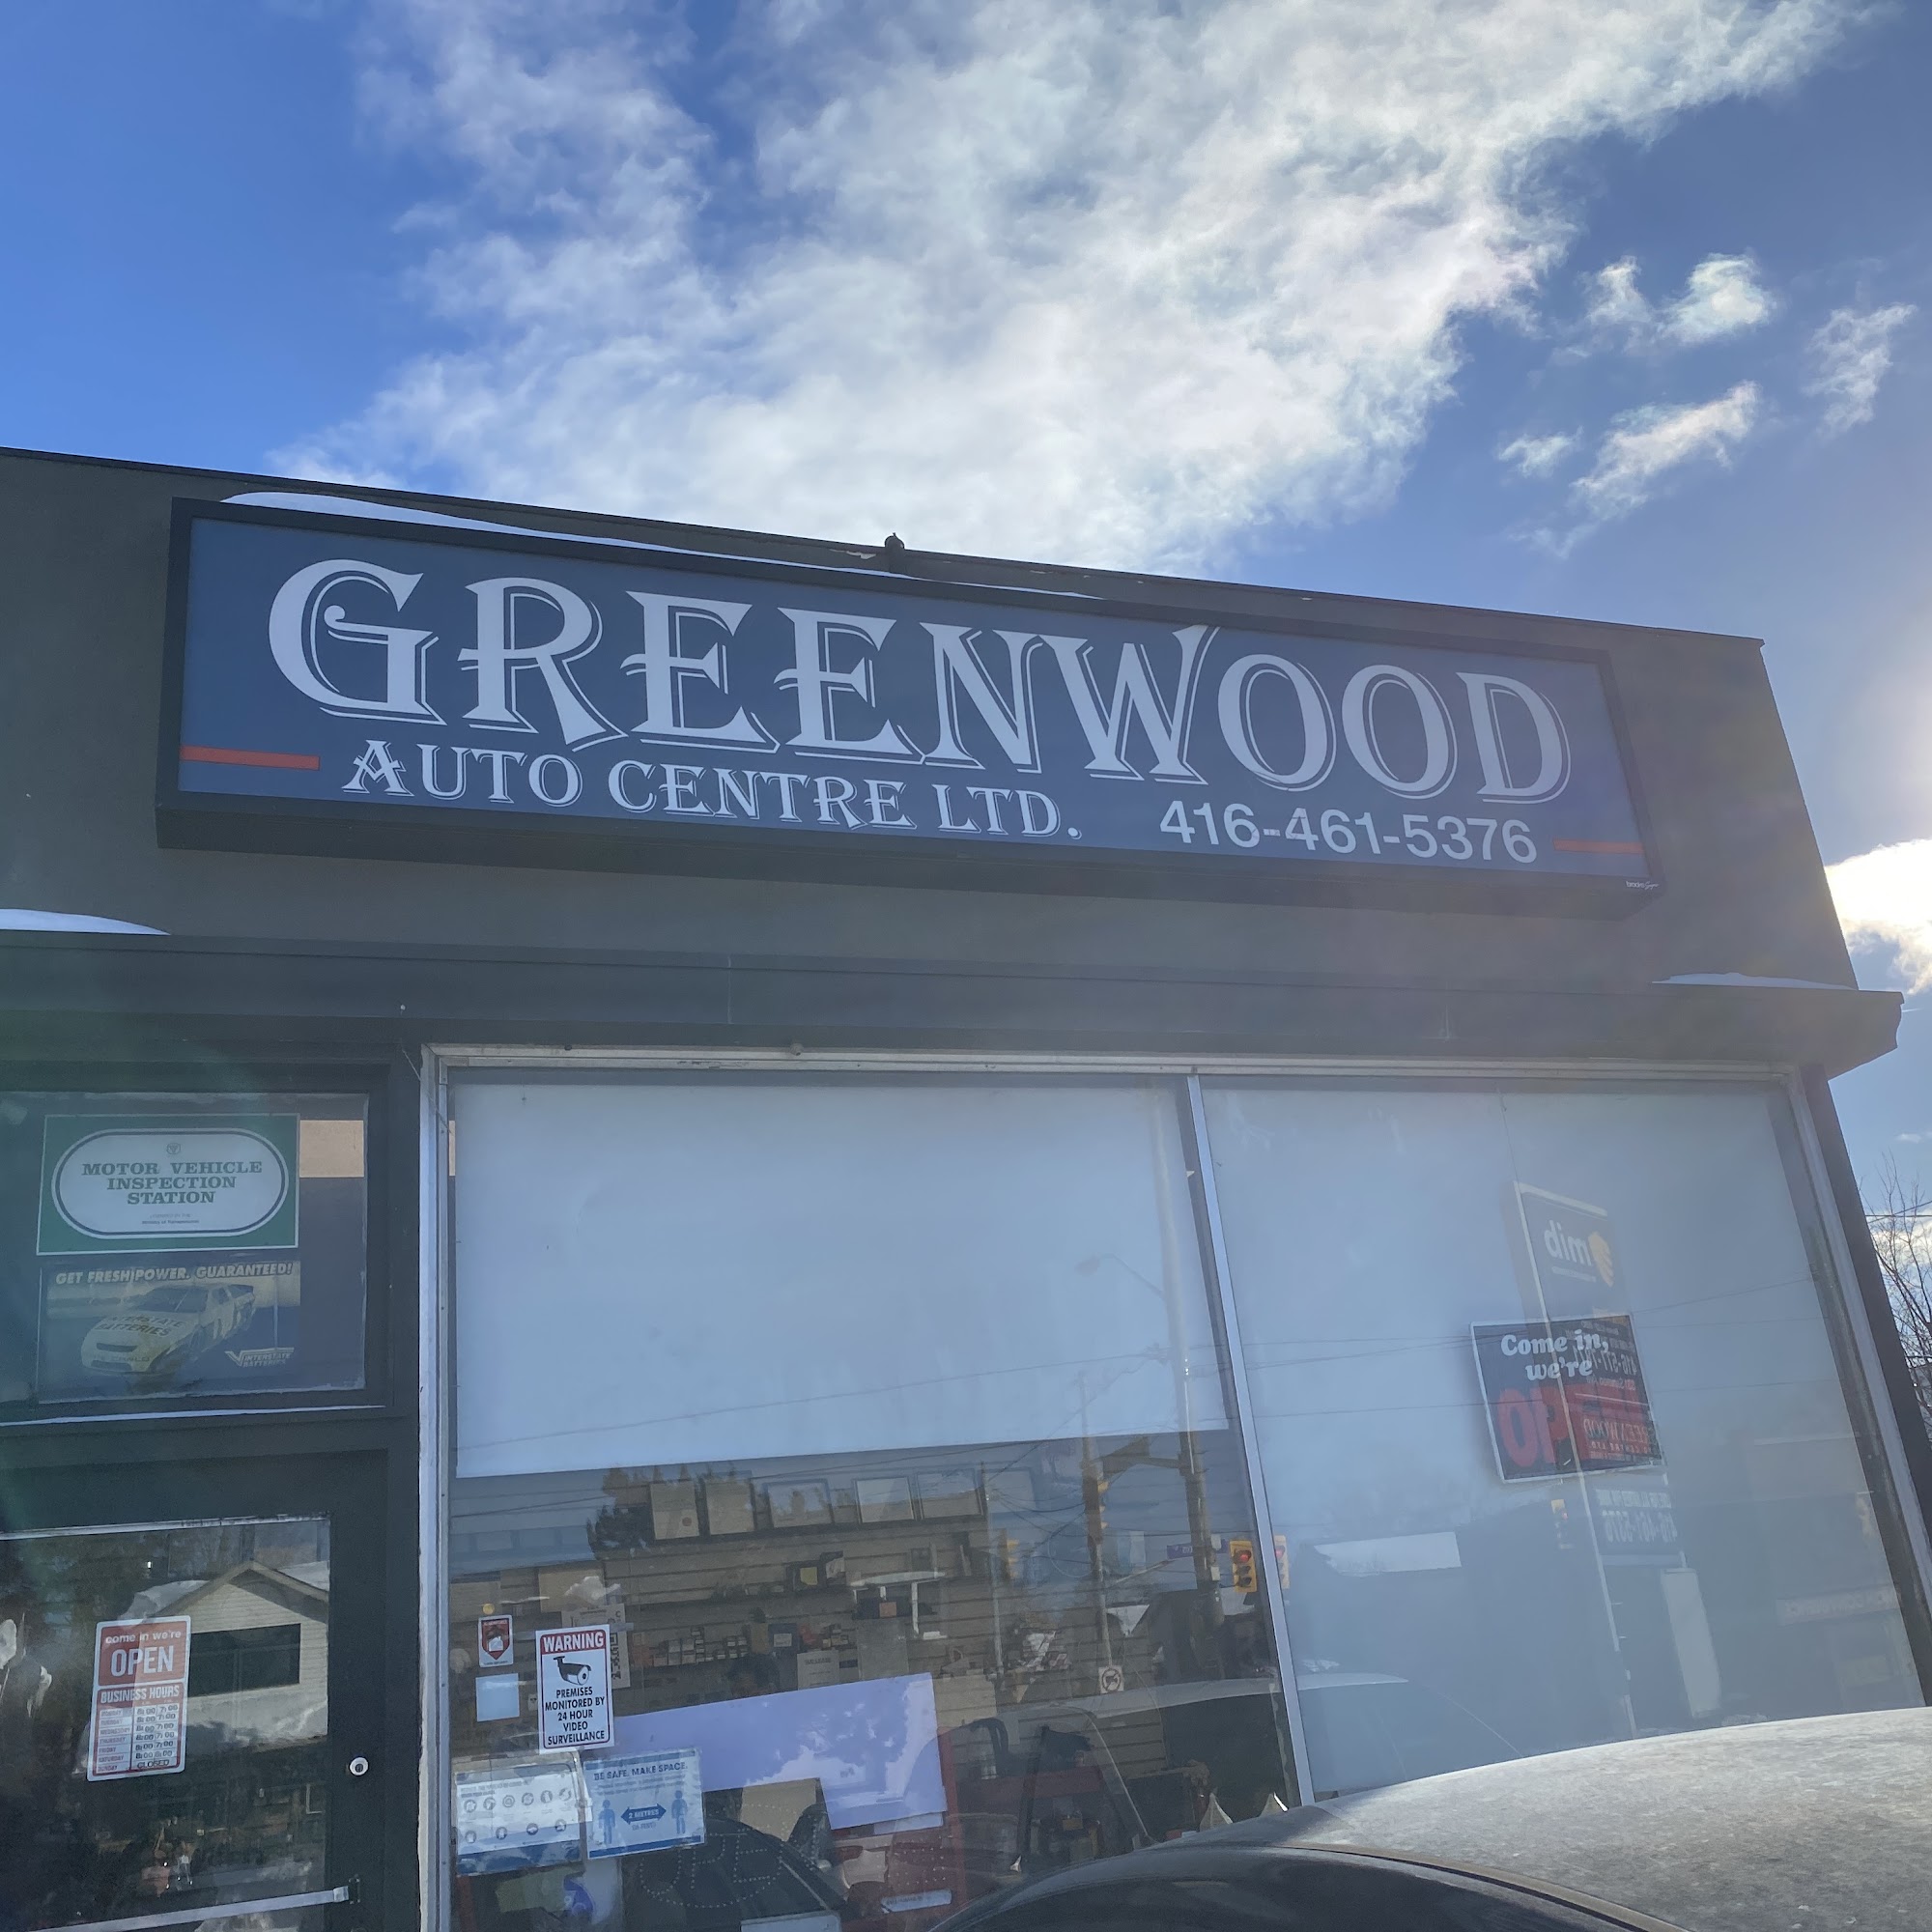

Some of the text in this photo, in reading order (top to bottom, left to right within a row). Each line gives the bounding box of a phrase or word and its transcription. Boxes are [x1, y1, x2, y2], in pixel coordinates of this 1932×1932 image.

[269, 558, 1573, 805] GREENWOOD
[341, 740, 1083, 839] AUTO CENTRE LTD.
[1159, 800, 1538, 864] 416-461-5376
[81, 1161, 263, 1176] MOTOR VEHICLE
[107, 1177, 237, 1190] INSPECTION
[128, 1191, 215, 1205] STATION
[56, 1263, 293, 1284] GET FRESH POWER. GUARANTEED!
[1501, 1334, 1567, 1356] Come
[1574, 1329, 1608, 1353] in,
[244, 1352, 291, 1361] INTERSTATE
[1525, 1356, 1592, 1380] we're
[105, 1630, 182, 1643] come in we're
[543, 1632, 604, 1653] WARNING
[111, 1645, 174, 1677] OPEN
[100, 1685, 180, 1704] BUSINESS HOURS
[556, 1687, 593, 1698] PREMISES
[546, 1696, 605, 1711] MONITORED BY
[558, 1710, 593, 1721] 24 HOUR
[562, 1720, 588, 1732] VIDEO
[548, 1730, 605, 1746] SURVEILLANCE
[137, 1759, 170, 1769] CLOSED
[607, 1770, 629, 1779] SAFE.
[632, 1766, 656, 1776] MAKE
[659, 1762, 688, 1774] SPACE.
